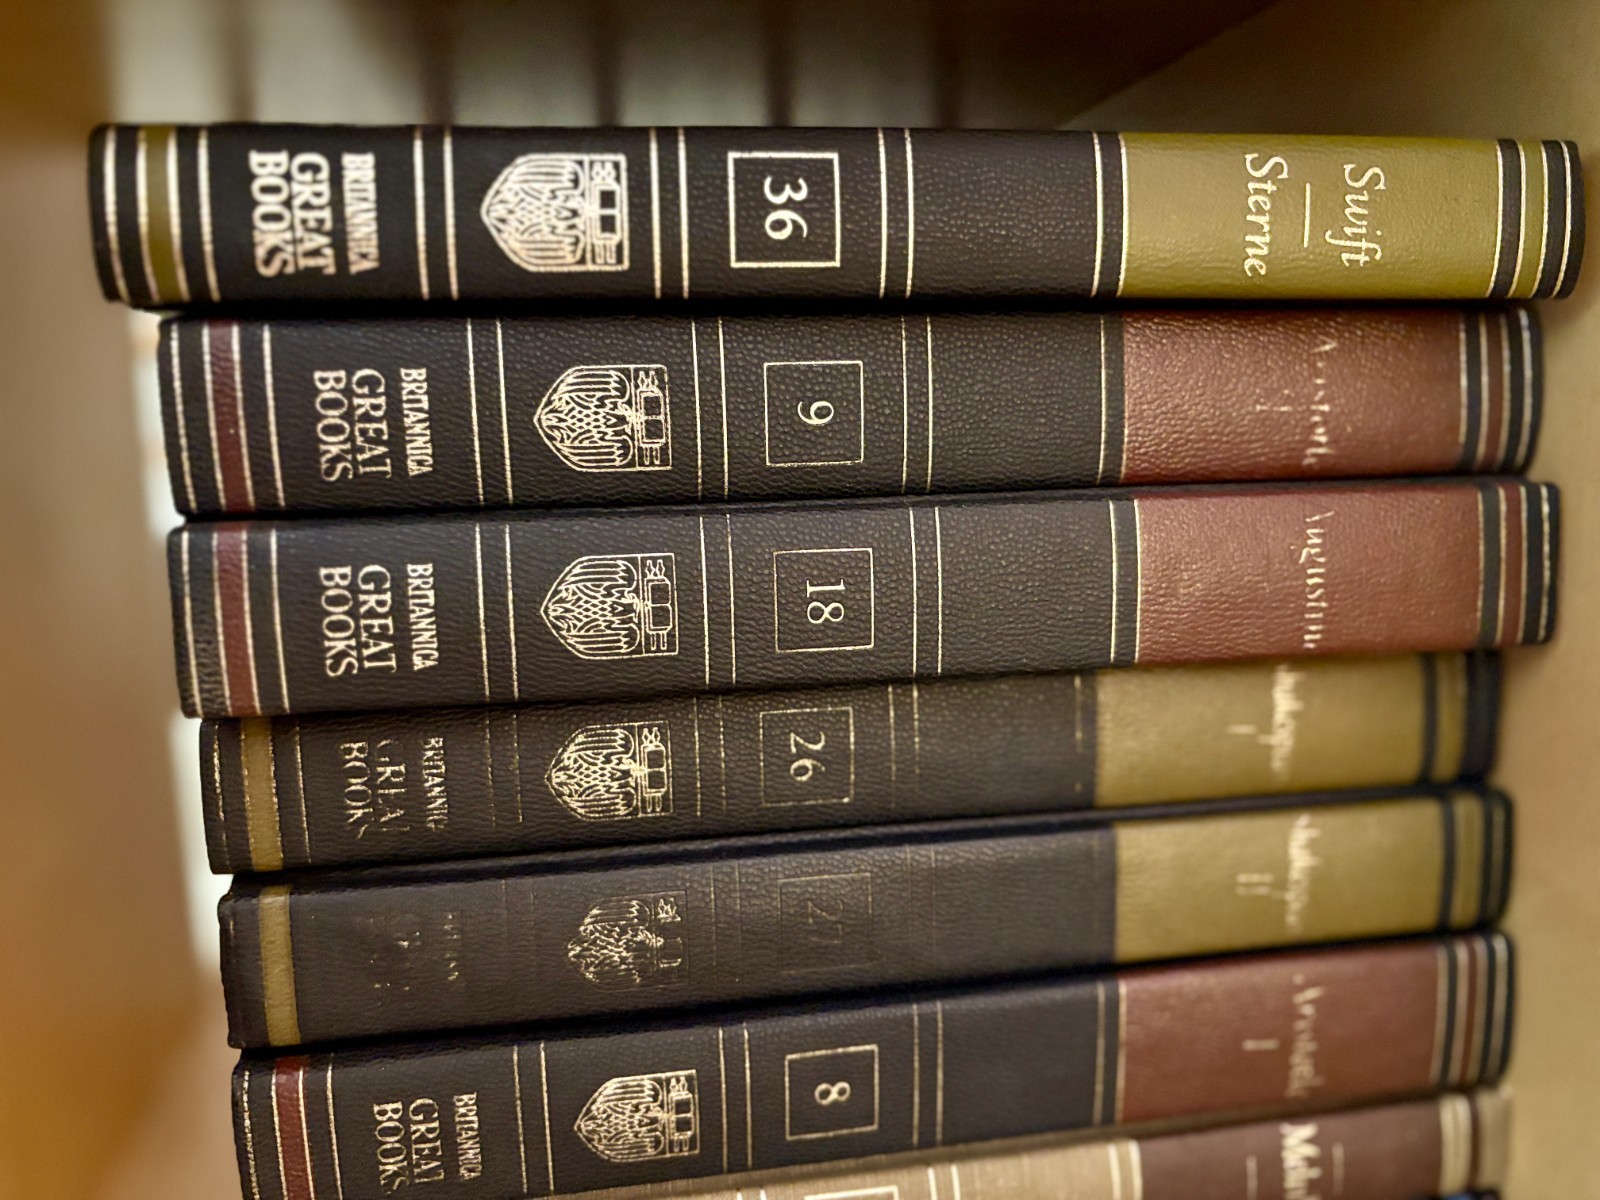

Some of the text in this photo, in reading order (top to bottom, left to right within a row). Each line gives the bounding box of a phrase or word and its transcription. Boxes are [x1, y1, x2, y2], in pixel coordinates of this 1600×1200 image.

[248, 149, 296, 277] BOOKS
[290, 152, 336, 275] GREAT
[341, 151, 380, 275] BRITANNICA
[763, 175, 808, 240] 36
[1243, 153, 1289, 277] Sterne
[1324, 163, 1387, 268] Swift
[313, 369, 353, 482] BOOKS
[352, 368, 392, 479] GREAT
[400, 367, 433, 477] BRITANNICA
[797, 400, 835, 425] 9
[319, 565, 358, 677] BOOKS
[357, 564, 397, 673] GREAT
[406, 563, 439, 671] BRITANNICA
[806, 578, 846, 625] 18
[789, 731, 826, 782] 26
[409, 1098, 444, 1184] GREAT
[453, 1092, 482, 1182] BRITANNICA
[814, 1081, 851, 1106] 8
[373, 1101, 410, 1196] BOOKS
